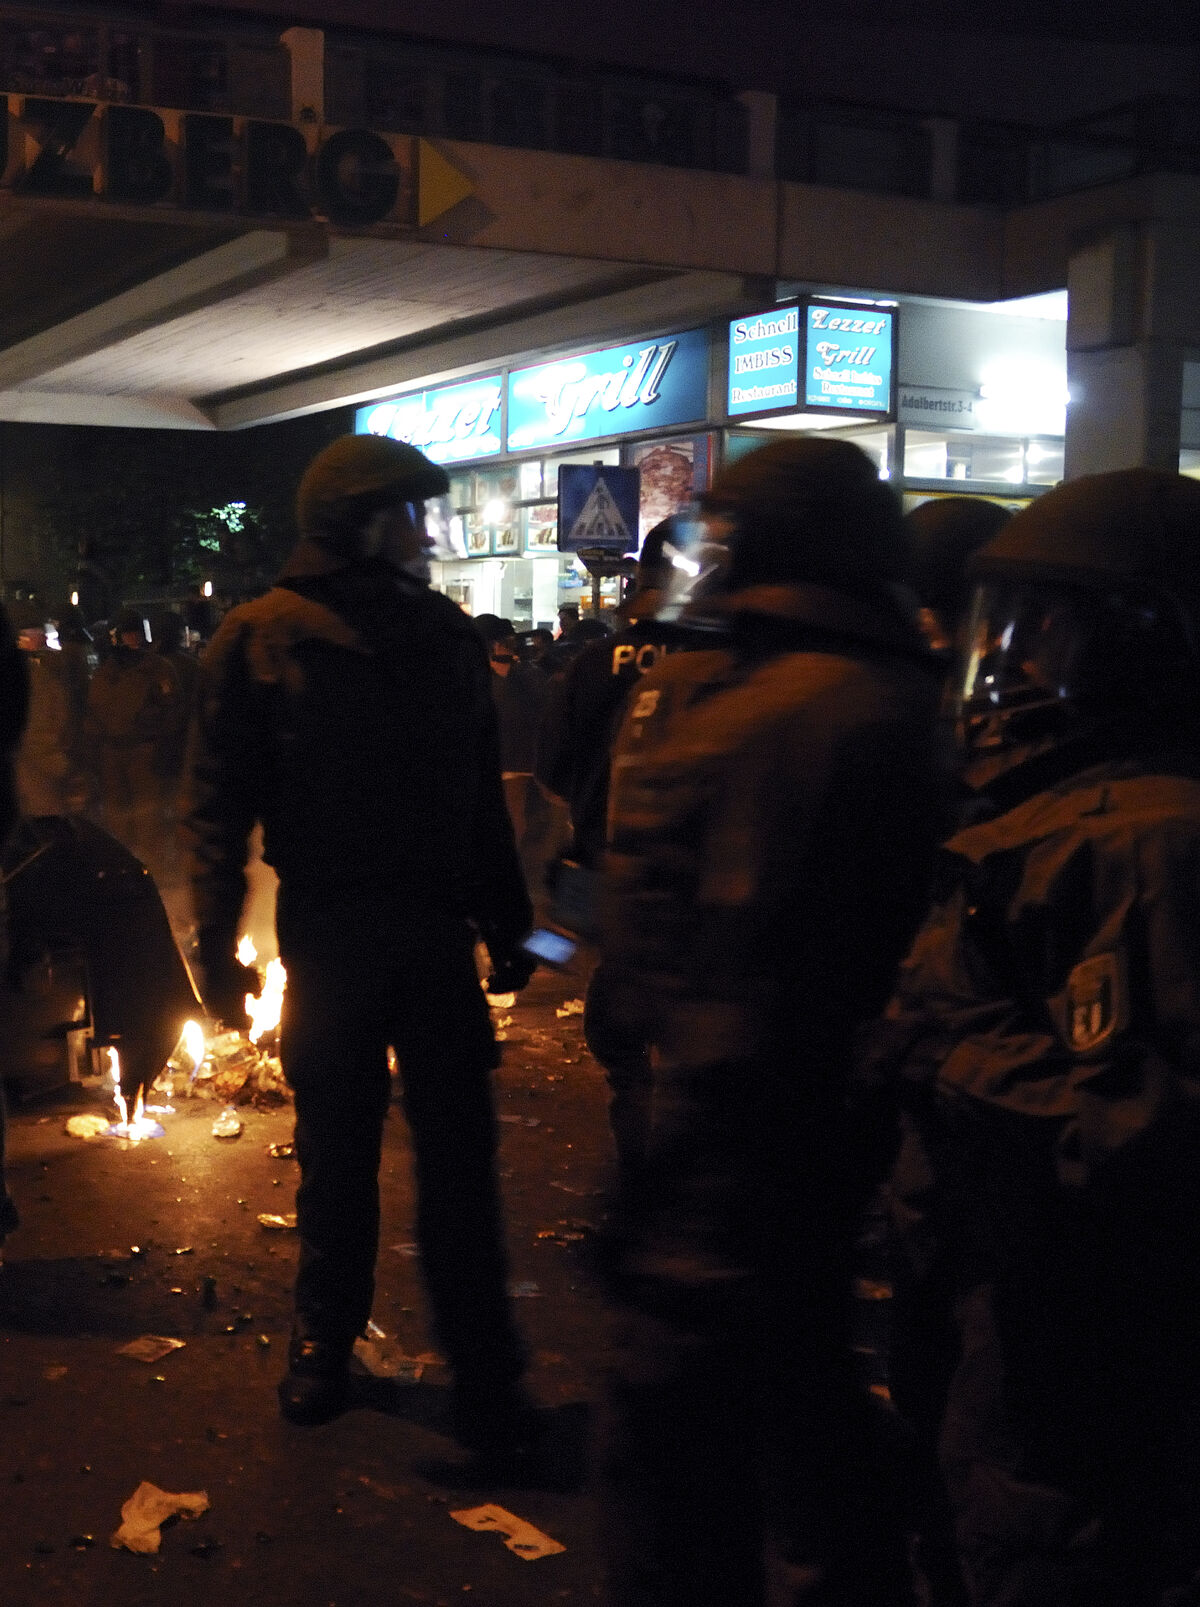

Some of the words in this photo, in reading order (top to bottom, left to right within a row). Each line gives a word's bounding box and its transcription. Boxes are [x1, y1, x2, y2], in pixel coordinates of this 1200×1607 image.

[734, 311, 798, 345] Schnell
[811, 309, 887, 336] Lezzet
[734, 346, 794, 374] IMBISS
[816, 341, 877, 366] Grill
[731, 379, 798, 404] Restaurant
